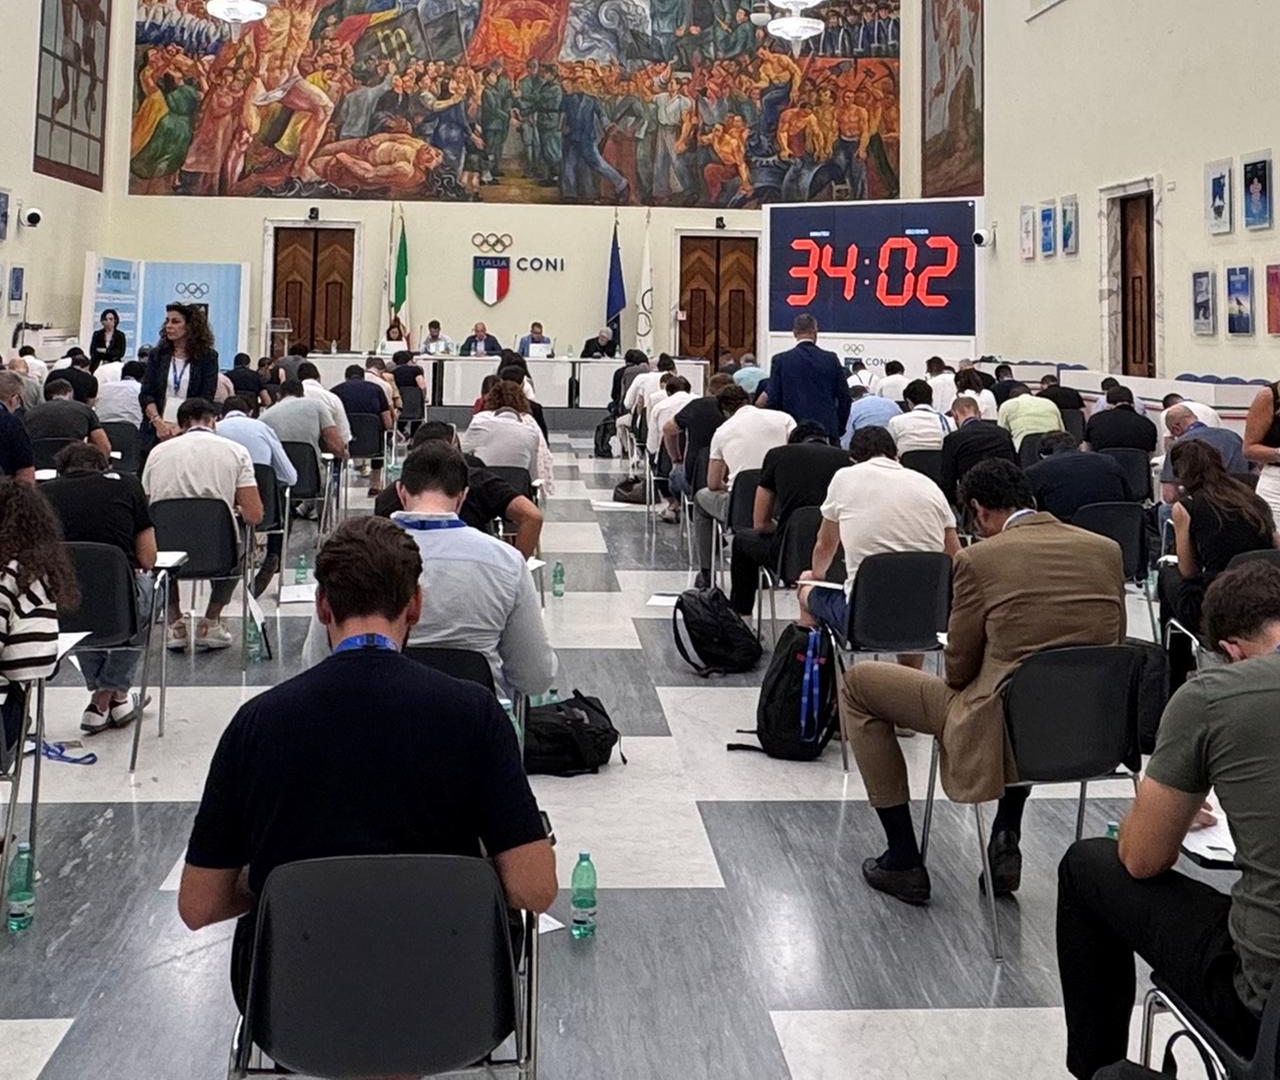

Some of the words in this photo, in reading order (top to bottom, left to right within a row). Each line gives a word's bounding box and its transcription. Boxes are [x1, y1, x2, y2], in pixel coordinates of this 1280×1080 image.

[476, 259, 507, 267] ITALIA
[516, 257, 564, 271] CONI
[786, 235, 959, 307] 34:02
[865, 357, 889, 367] CON
